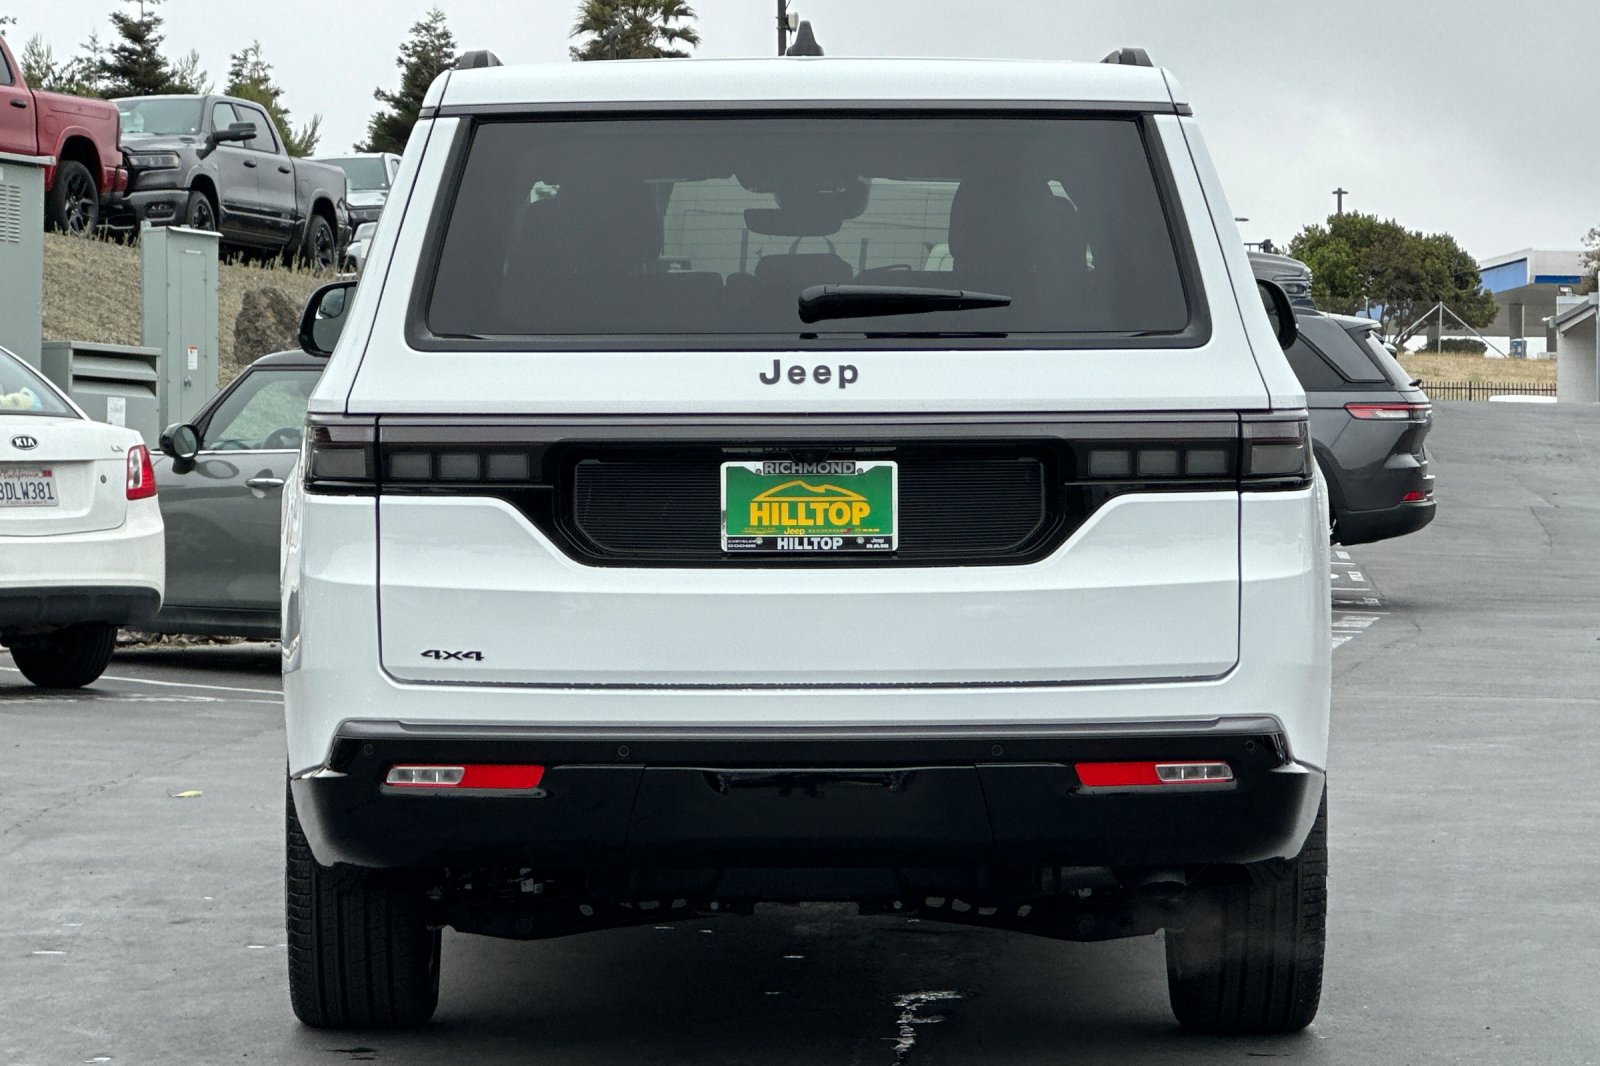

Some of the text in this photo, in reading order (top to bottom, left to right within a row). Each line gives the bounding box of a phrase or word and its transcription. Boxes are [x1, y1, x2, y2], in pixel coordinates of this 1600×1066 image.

[759, 359, 858, 389] Jeep
[14, 437, 35, 447] KIA
[764, 462, 854, 474] RICHMOND
[750, 502, 871, 526] HILLTOP
[783, 527, 805, 535] Jeep
[777, 537, 843, 550] HILLTOP
